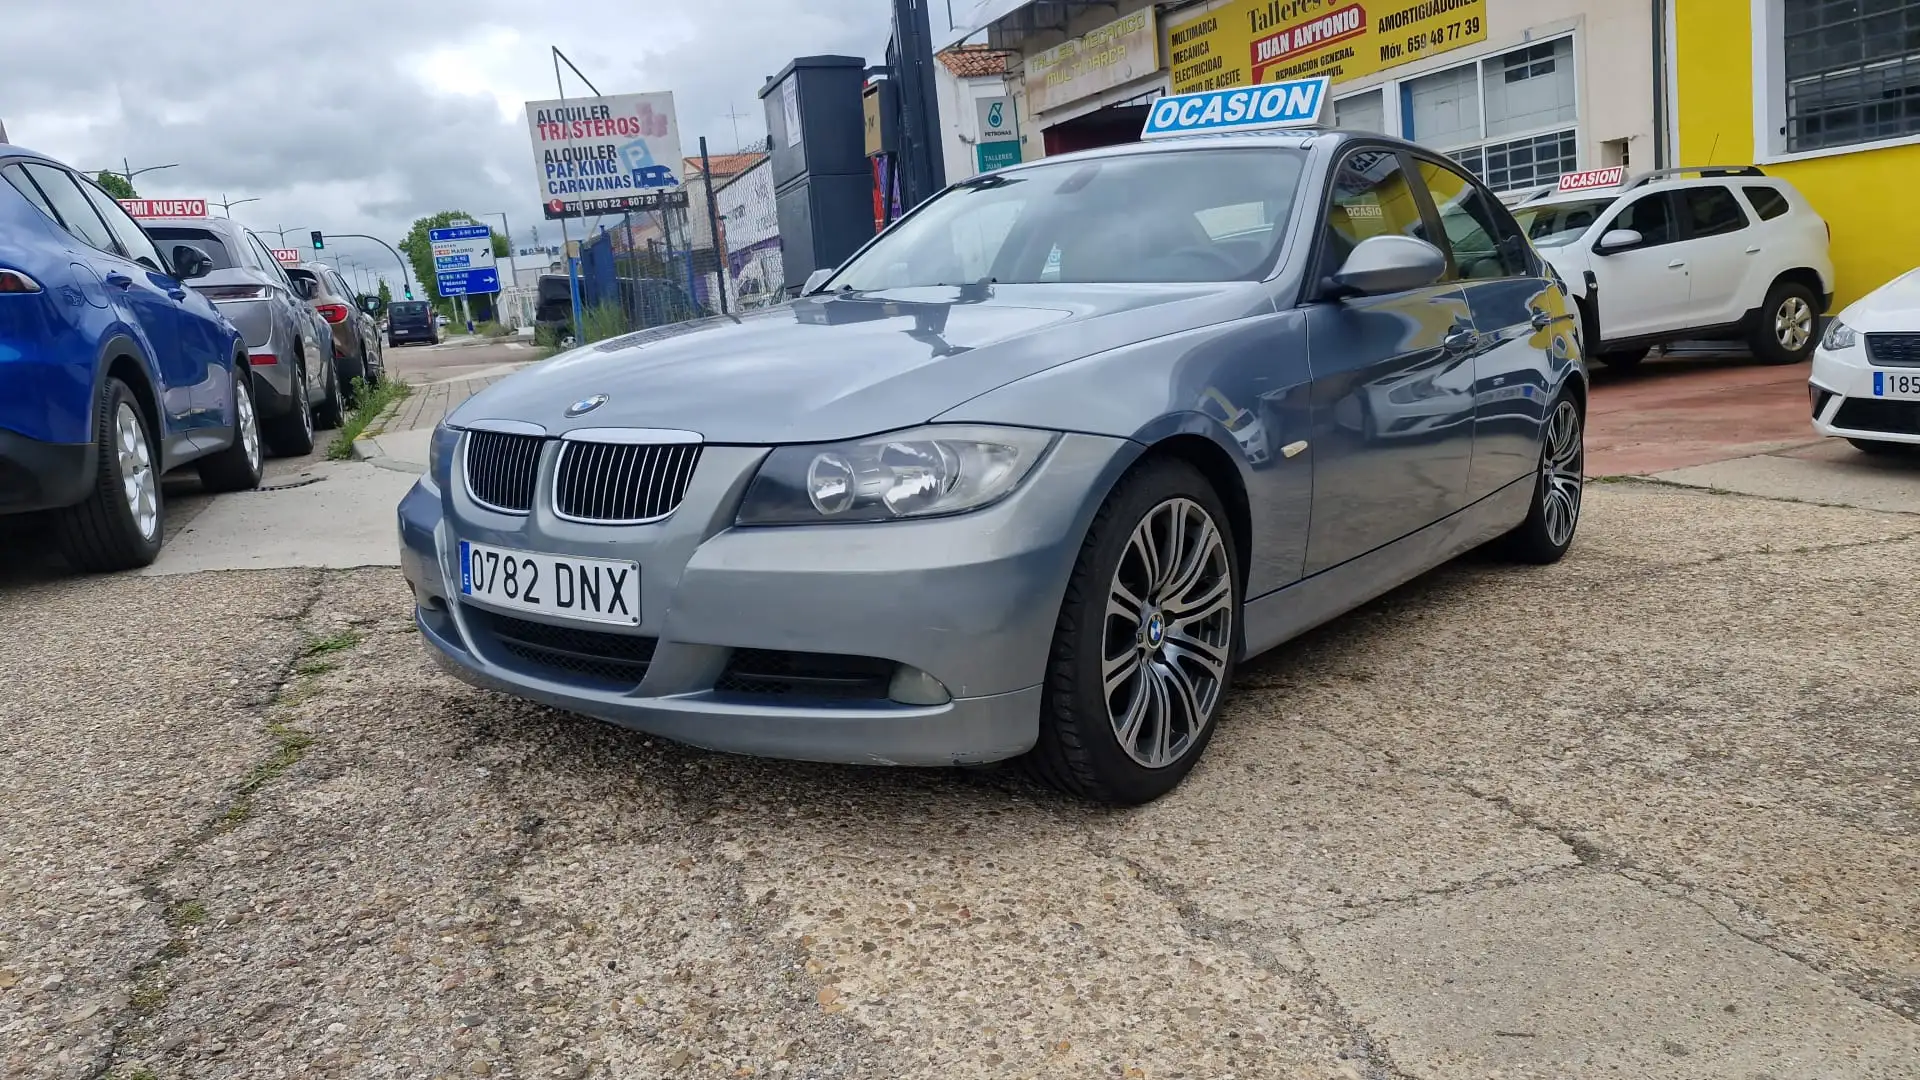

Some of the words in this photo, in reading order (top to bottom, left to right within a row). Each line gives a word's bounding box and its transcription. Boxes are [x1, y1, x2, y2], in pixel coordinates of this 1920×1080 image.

[1379, 0, 1477, 34] AMORTIGUADOR
[1171, 18, 1218, 47] MULTIMARCA
[1257, 32, 1290, 62] JUAN
[1293, 8, 1360, 49] ANTONIO
[1380, 43, 1404, 61] Móv.
[1408, 34, 1427, 53] 659
[1430, 28, 1444, 45] 48
[1447, 22, 1461, 41] 77
[1465, 17, 1480, 35] 39
[1320, 47, 1355, 67] GENERAL
[1174, 56, 1222, 84] ELECTRICIDAD
[1205, 78, 1214, 91] DE
[1215, 69, 1241, 88] ACEITE
[537, 104, 611, 124] ALQUILER
[1154, 84, 1316, 129] OCASION
[537, 116, 641, 141] TRASTEROS
[544, 145, 618, 164] ALQUILER
[984, 153, 1013, 162] TALLERES
[548, 175, 632, 195] CARAVANAS
[1561, 168, 1620, 189] OCASION
[122, 201, 148, 215] EMI
[152, 201, 203, 215] NUEVO
[584, 201, 595, 210] 91
[597, 199, 609, 209] 00
[610, 198, 622, 208] 22
[1889, 376, 1920, 393] 185
[471, 549, 540, 604] 0782
[555, 562, 628, 615] DNX
